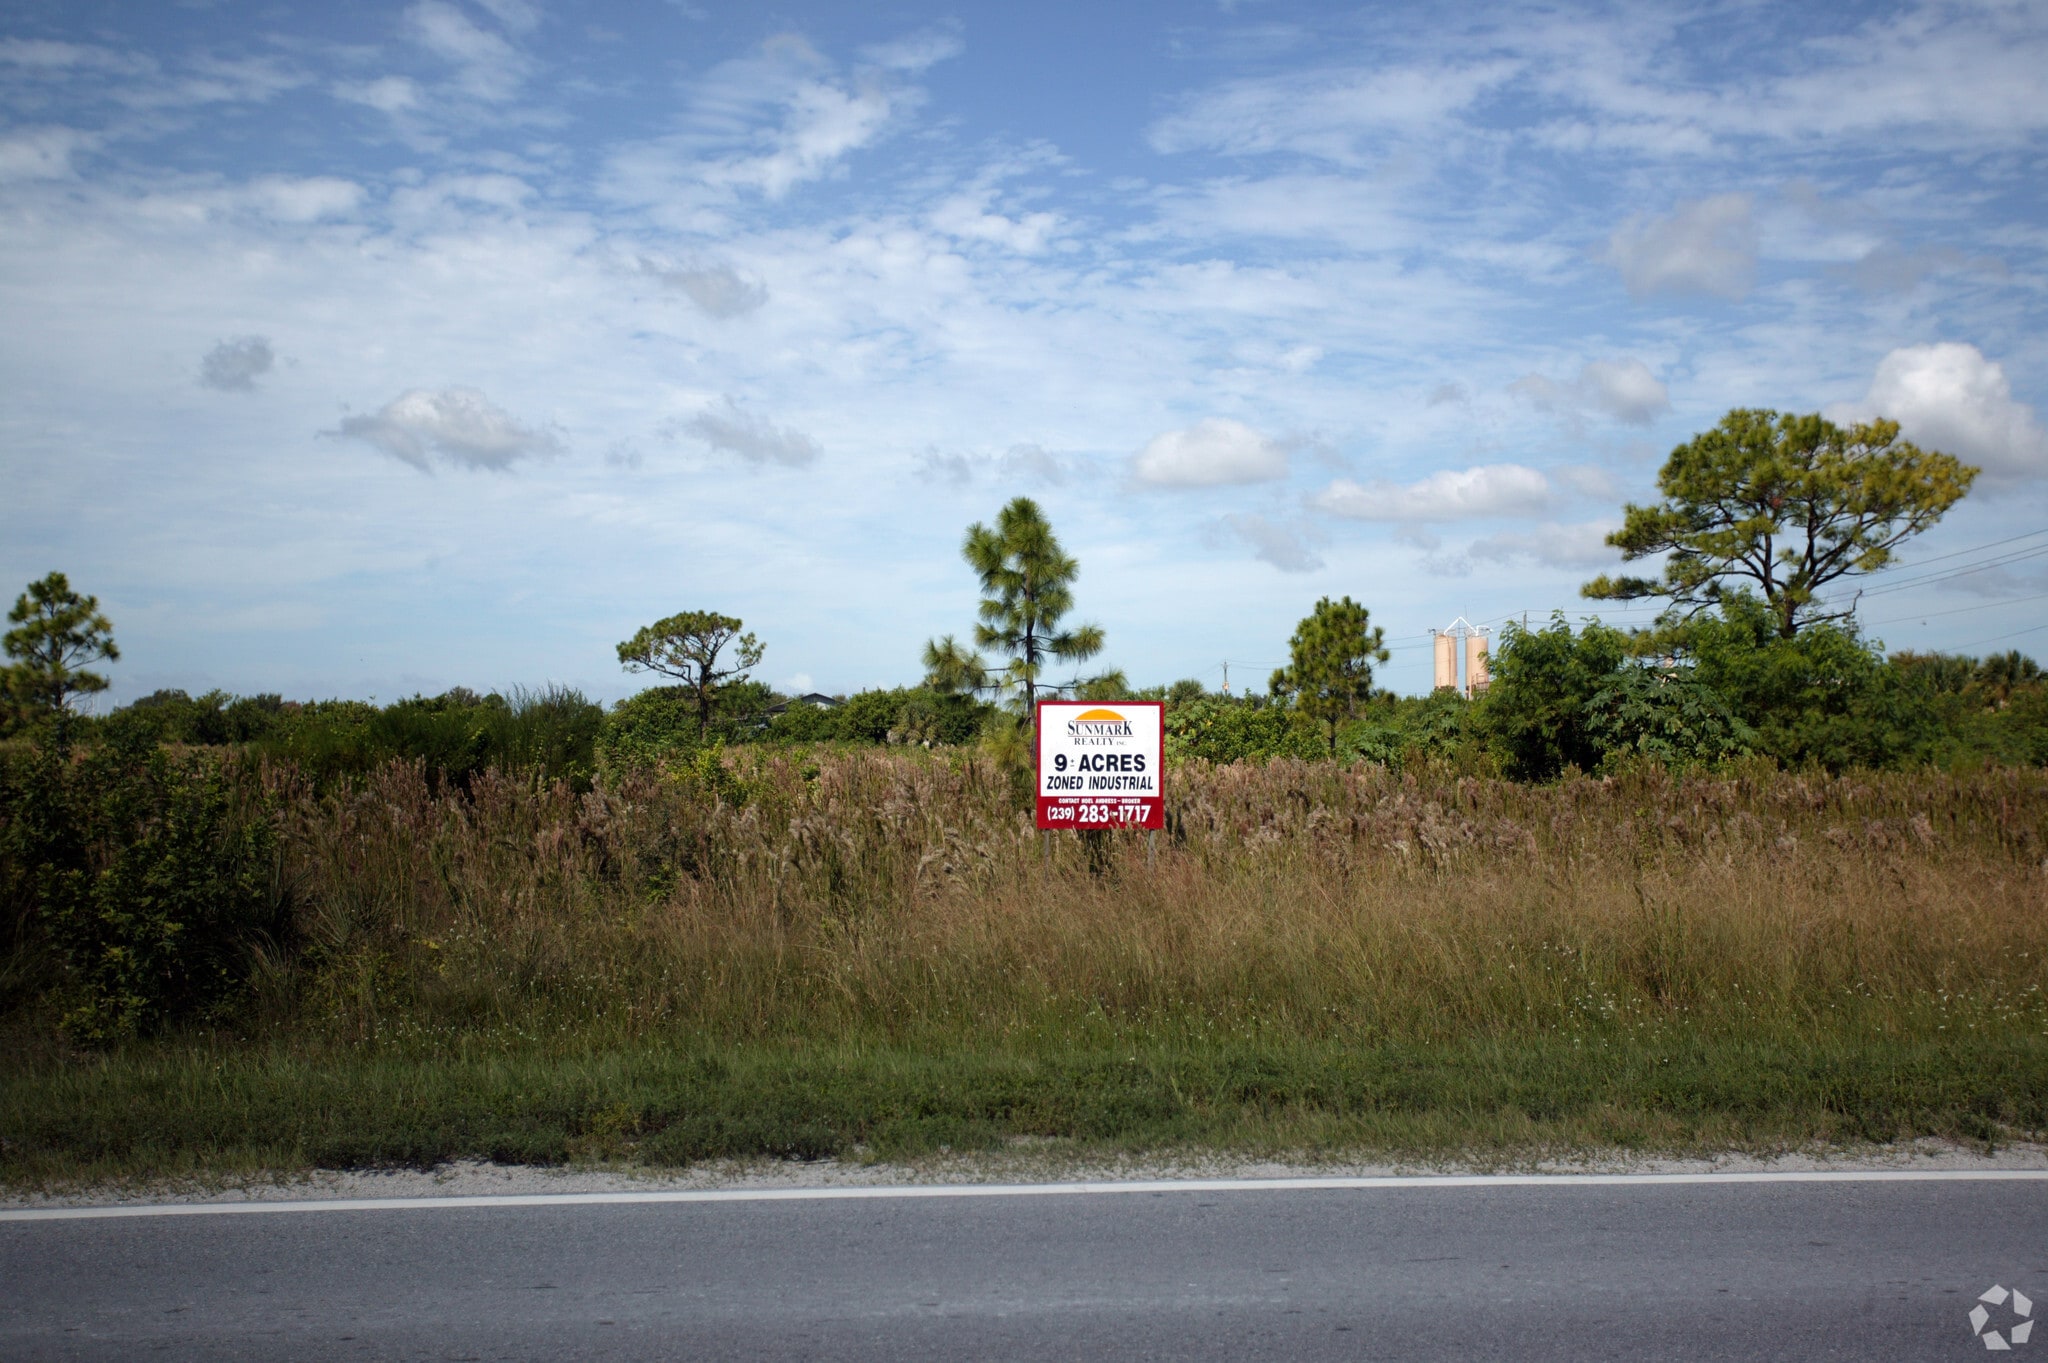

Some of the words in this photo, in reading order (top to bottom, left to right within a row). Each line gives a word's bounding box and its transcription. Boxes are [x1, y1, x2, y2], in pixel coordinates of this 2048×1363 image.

[1068, 720, 1132, 735] SUNMARK
[1074, 737, 1114, 746] REALTY
[1054, 753, 1068, 772] 9
[1078, 753, 1146, 772] ACRES
[1047, 776, 1083, 790] ZONED
[1088, 776, 1153, 790] INDUSTRIAL
[1047, 805, 1075, 821] (239)
[1078, 805, 1151, 822] 283-1717
